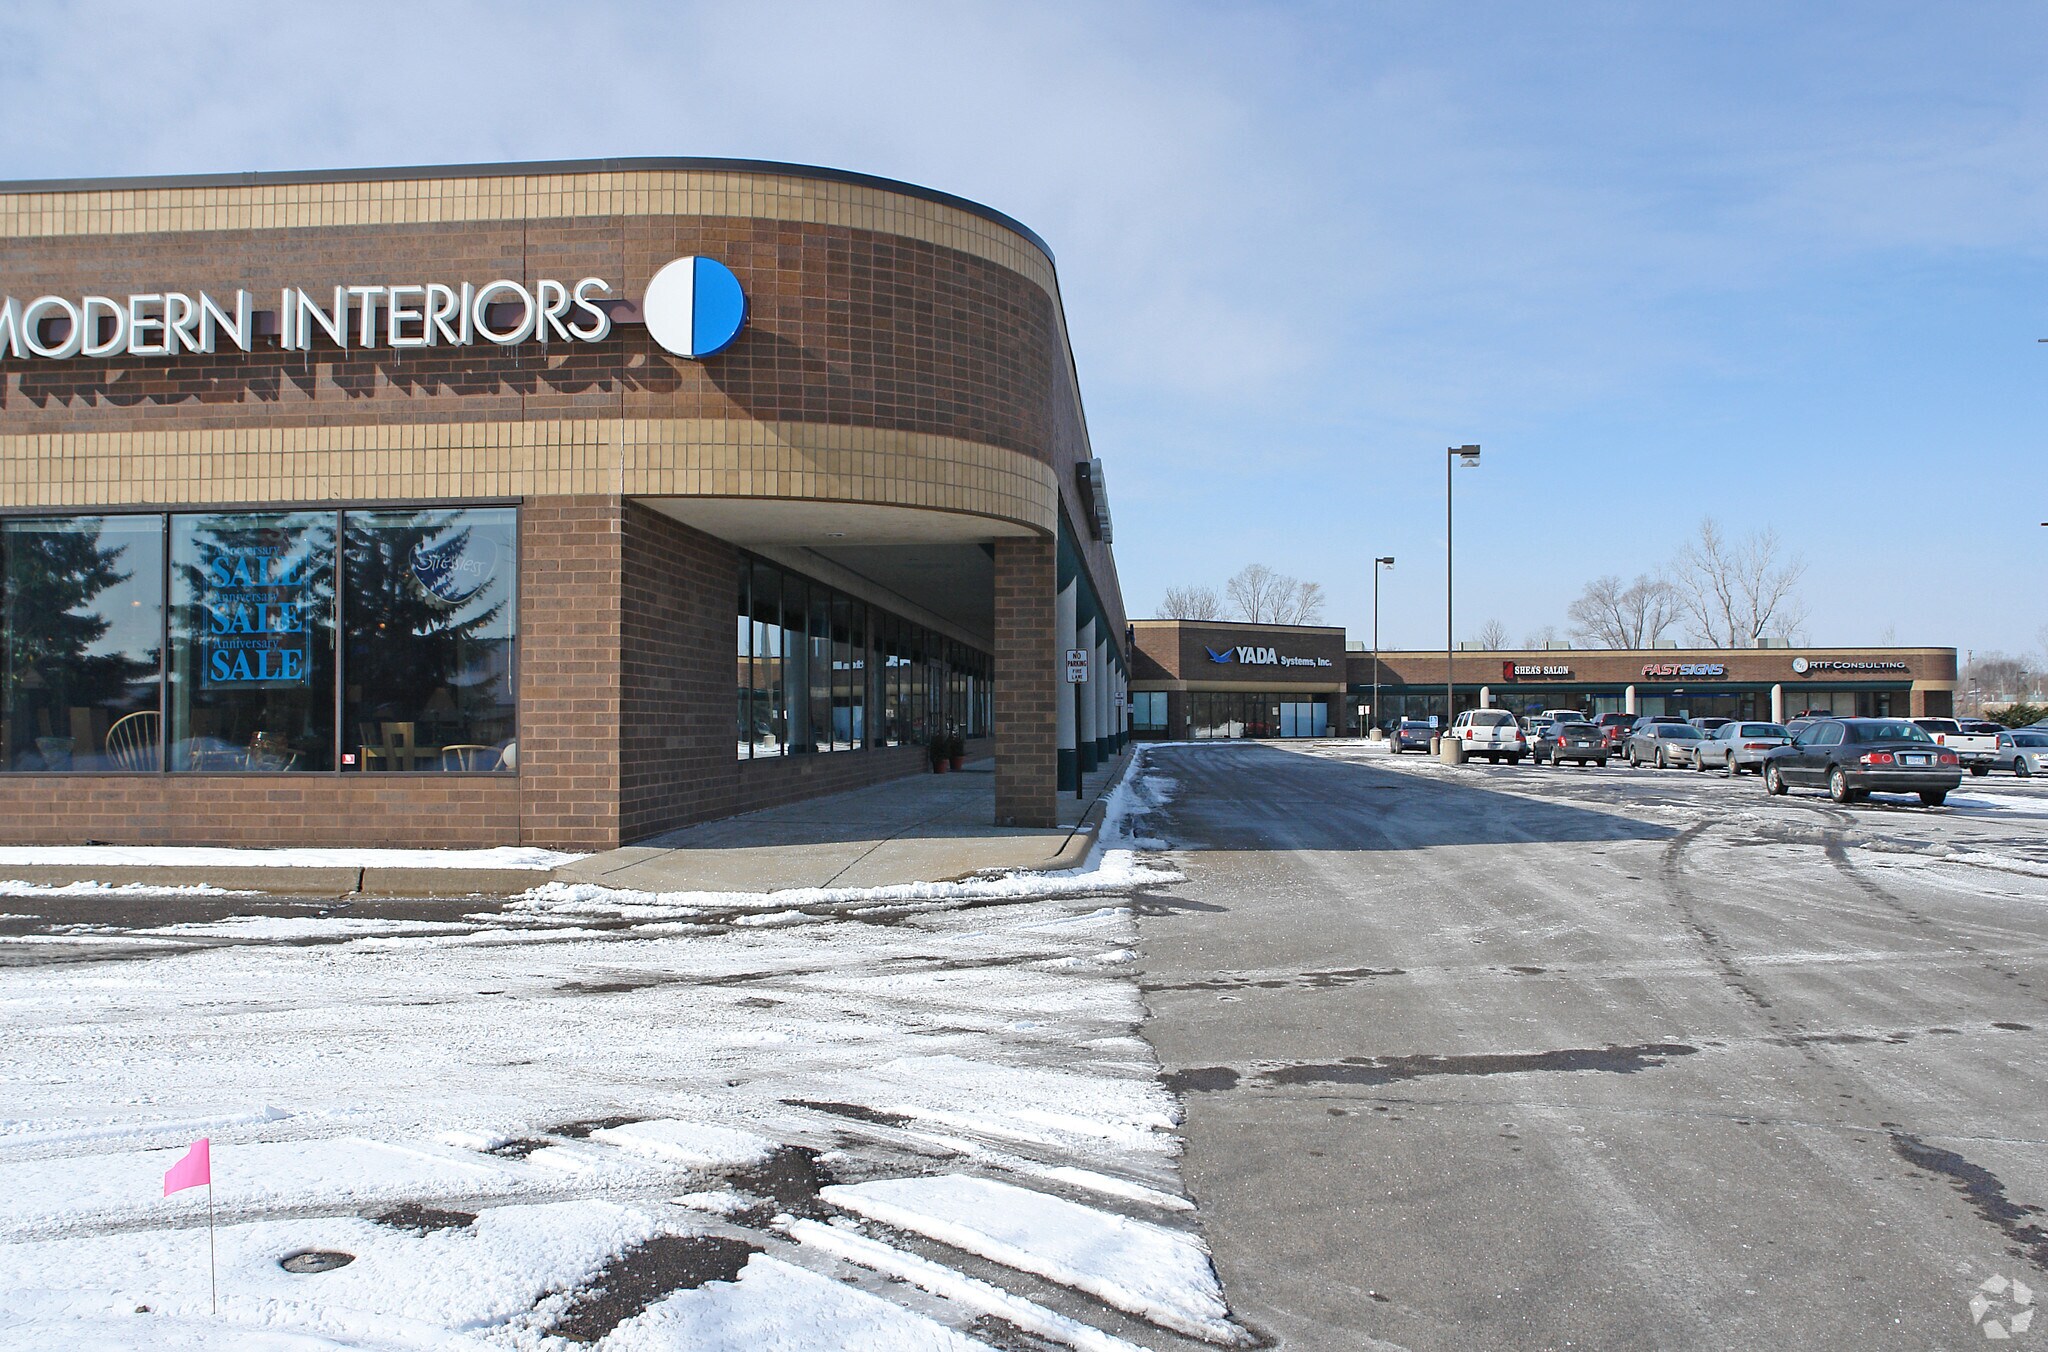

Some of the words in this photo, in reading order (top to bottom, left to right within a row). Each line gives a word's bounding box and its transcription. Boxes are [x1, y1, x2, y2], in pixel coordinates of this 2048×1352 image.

[280, 276, 614, 351] INTERIORS
[211, 556, 303, 587] SALE
[213, 592, 279, 603] Anniversary
[211, 602, 303, 635] SALE
[213, 638, 279, 650] Anniversary
[210, 649, 303, 681] SALE
[1236, 646, 1278, 665] YADA
[1280, 656, 1316, 668] Systems,
[1317, 657, 1333, 667] Inc.
[1809, 661, 1833, 669] RTF
[1514, 665, 1541, 675] SHEA'S
[1543, 665, 1569, 675] SALON
[1641, 663, 1724, 675] FASTSIGNS
